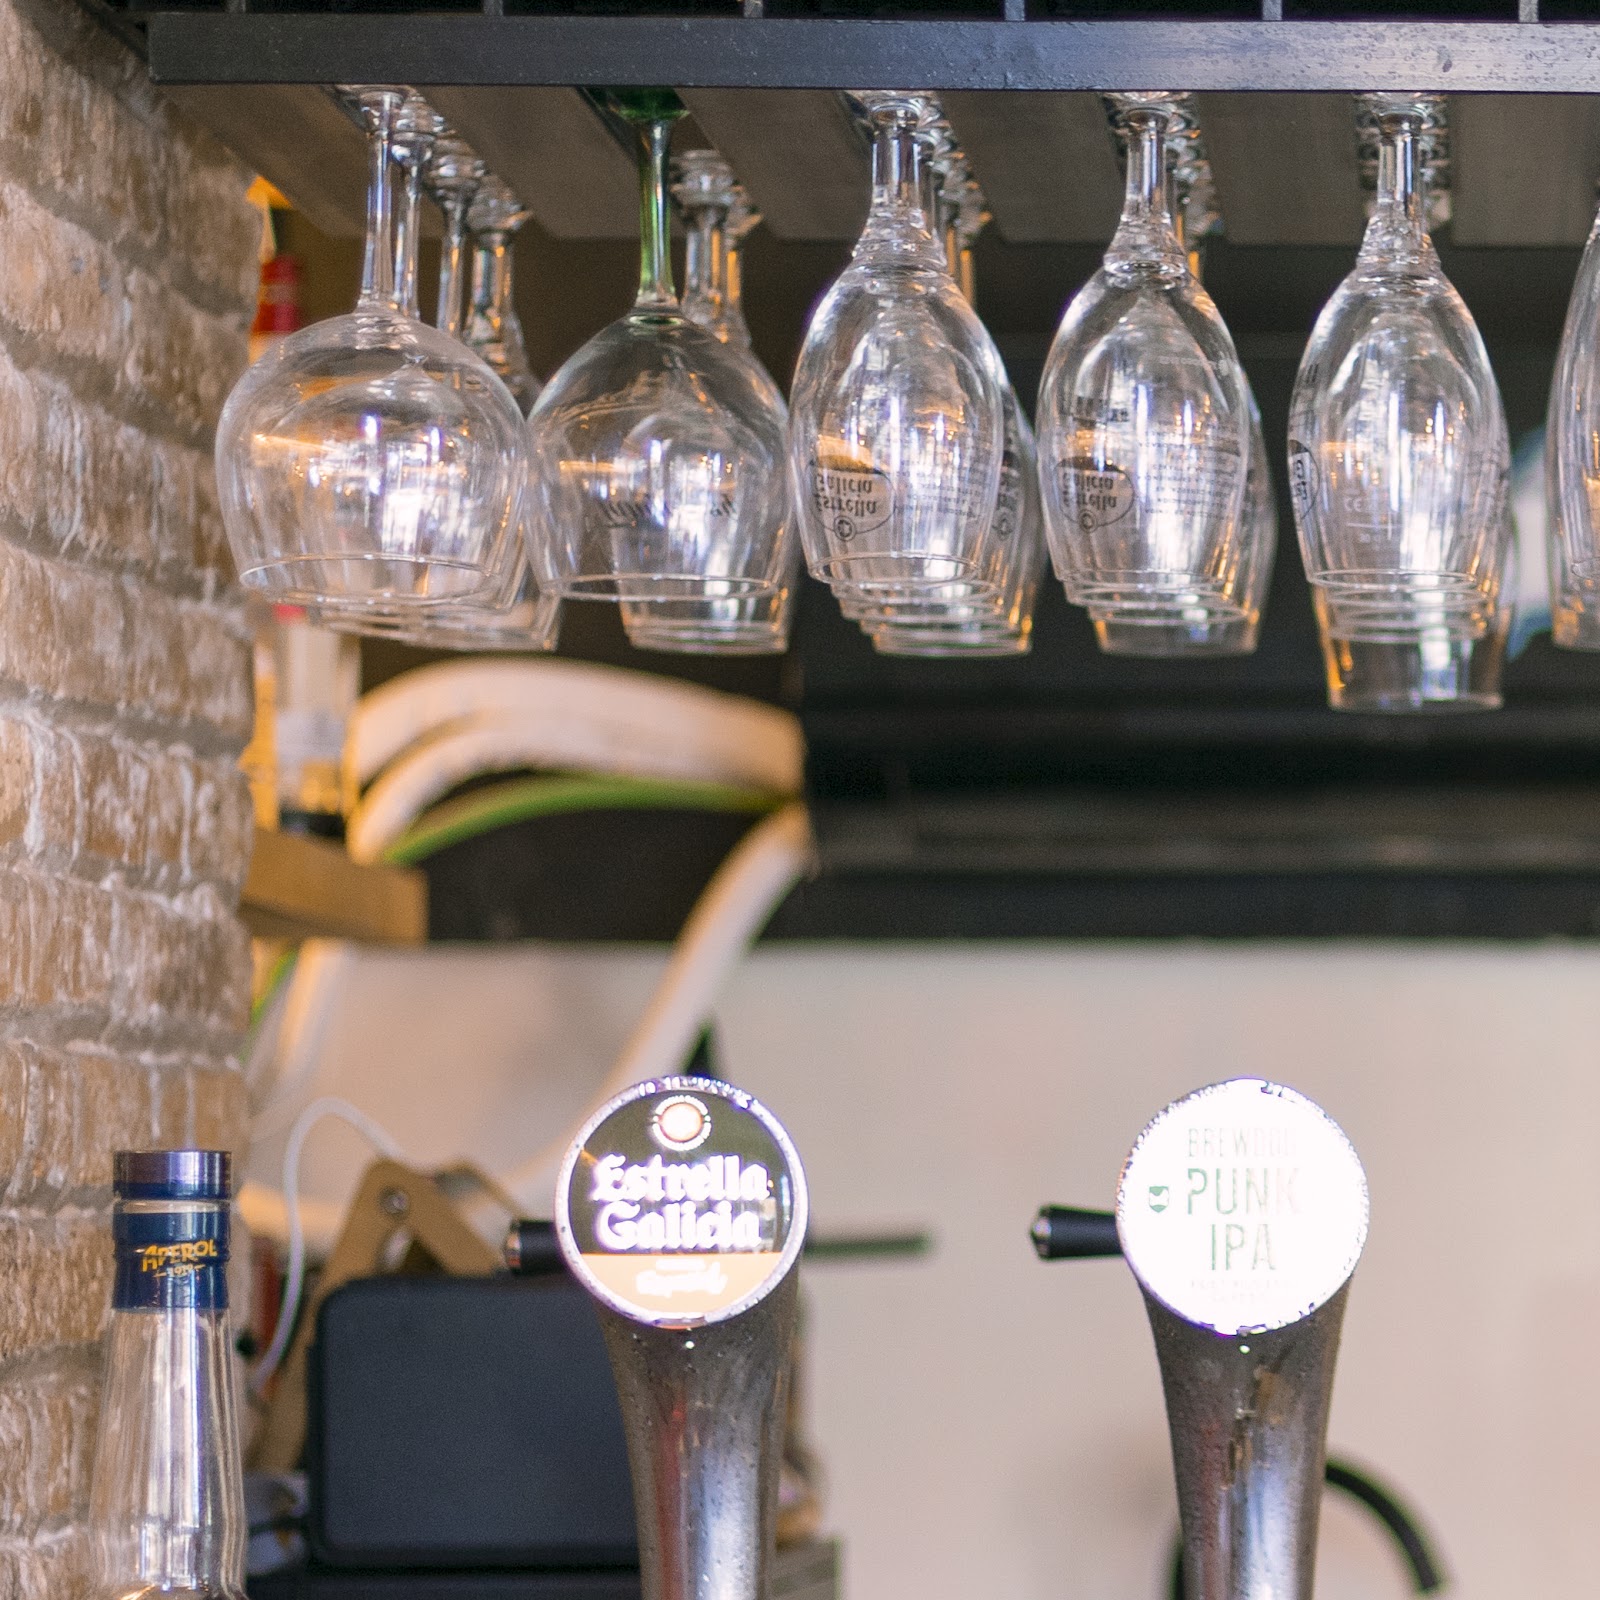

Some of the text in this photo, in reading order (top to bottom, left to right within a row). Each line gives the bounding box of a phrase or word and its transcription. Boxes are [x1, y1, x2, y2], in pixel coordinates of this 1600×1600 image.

[591, 1154, 770, 1201] Estrella
[1188, 1168, 1305, 1215] PUNK
[598, 1200, 762, 1250] Galicia
[1211, 1224, 1276, 1271] IPA
[142, 1239, 218, 1273] APEROL
